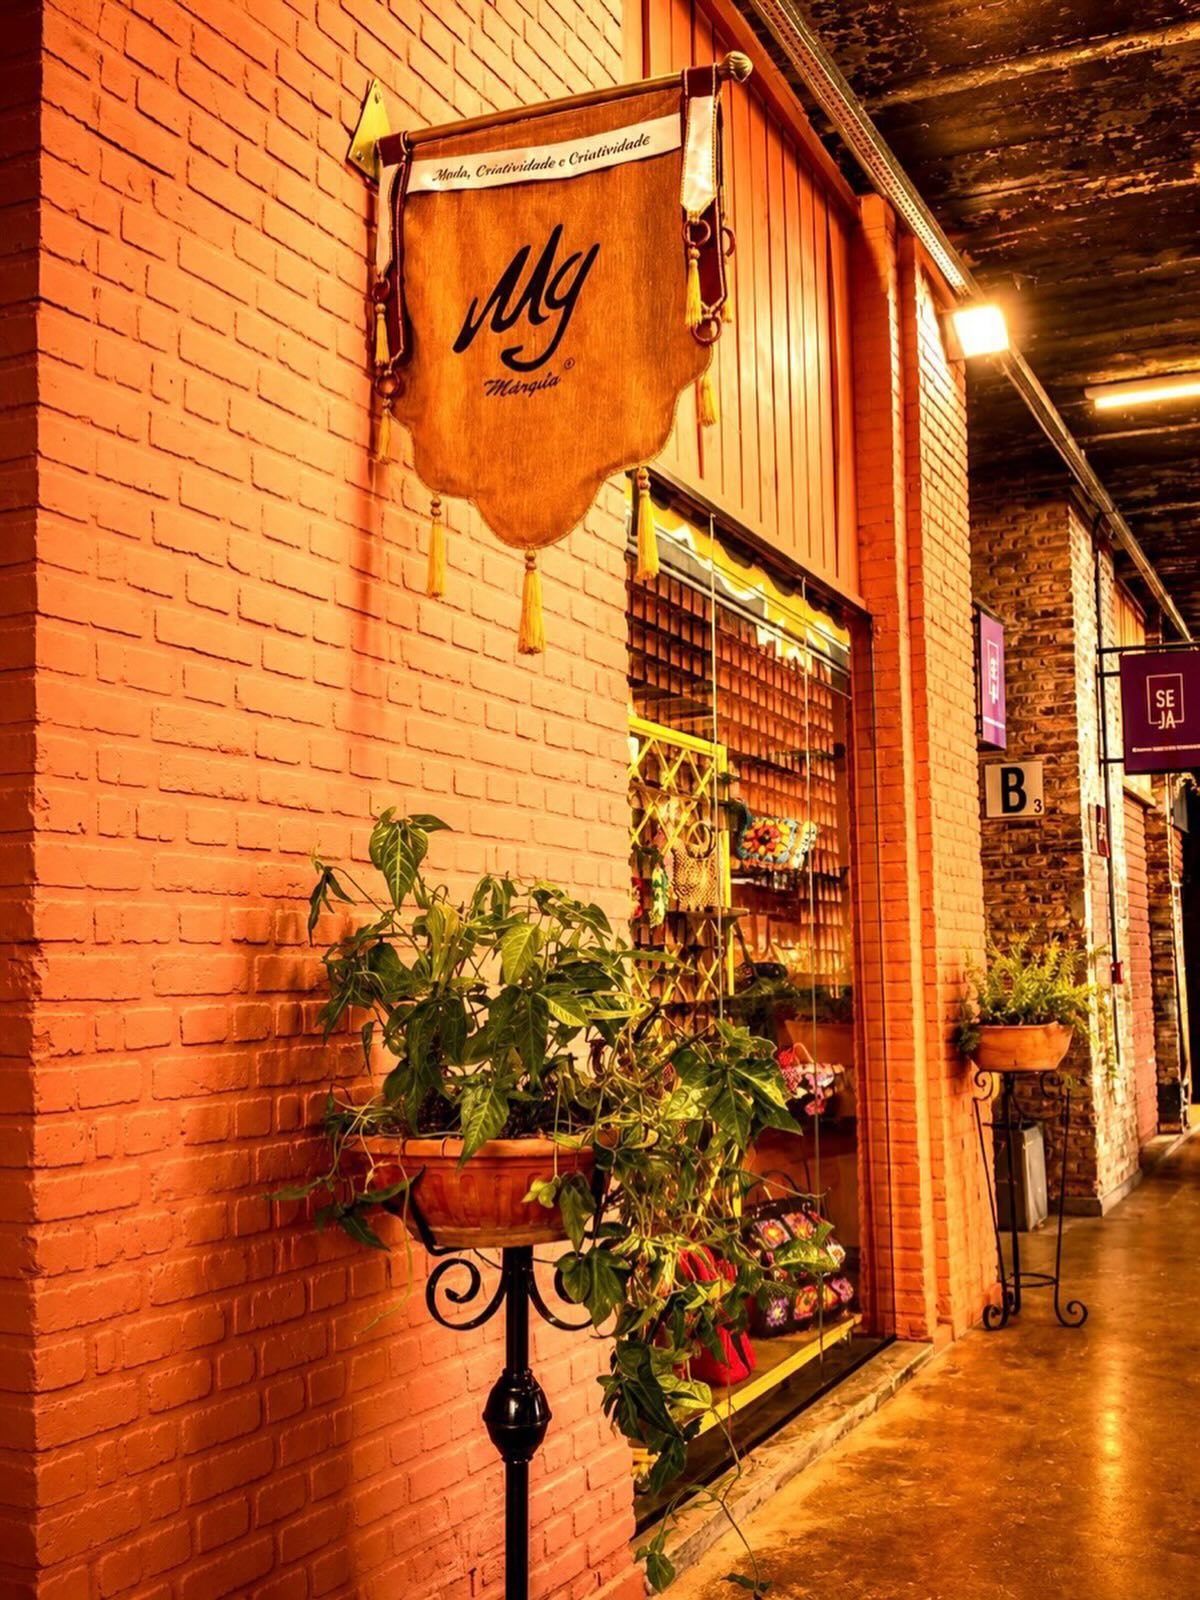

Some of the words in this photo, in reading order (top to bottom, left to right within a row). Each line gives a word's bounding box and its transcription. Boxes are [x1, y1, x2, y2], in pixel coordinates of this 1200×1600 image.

[475, 155, 556, 178] Criatividade
[569, 133, 651, 165] Criatividade
[1156, 689, 1175, 708] SE
[1158, 709, 1176, 730] JA
[1000, 766, 1027, 814] B
[1034, 799, 1043, 814] 3
